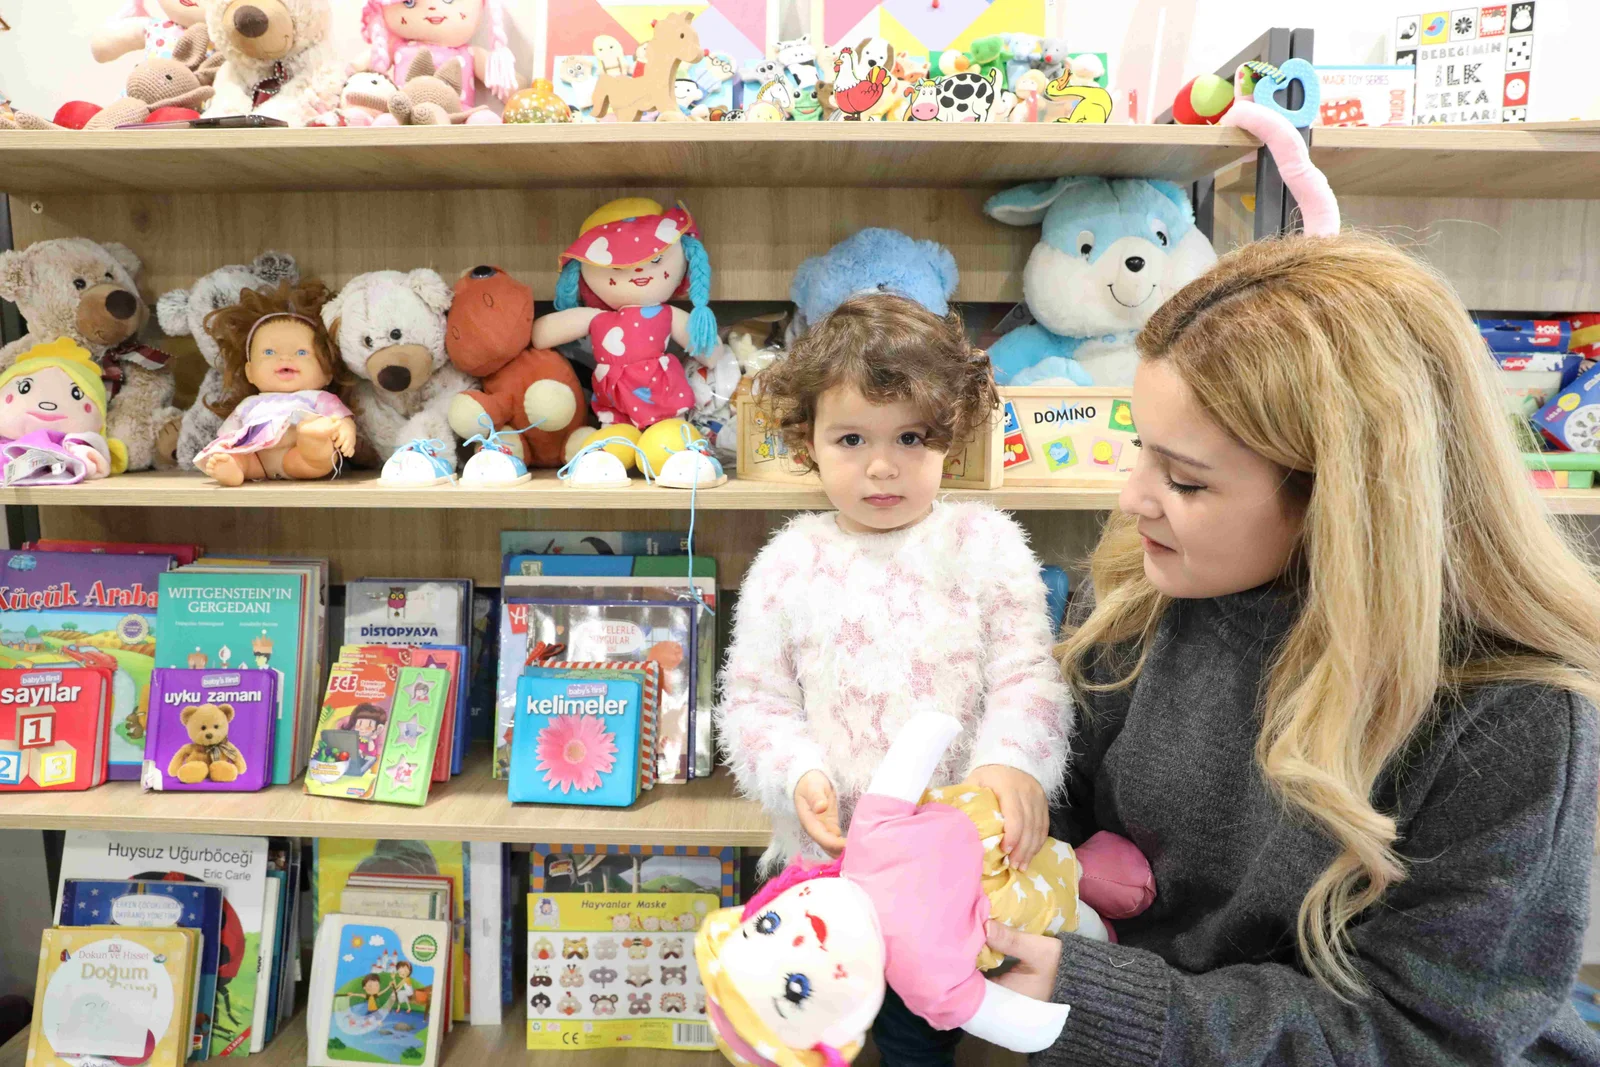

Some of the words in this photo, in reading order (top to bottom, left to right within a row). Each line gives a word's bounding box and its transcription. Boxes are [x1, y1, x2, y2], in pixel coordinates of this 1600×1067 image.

[1425, 89, 1489, 109] ZEKA
[1034, 406, 1096, 424] DOMINO
[83, 580, 158, 607] Araba
[188, 601, 271, 613] GERGEDANI
[22, 674, 45, 684] baby's
[46, 673, 60, 682] first
[329, 675, 357, 691] ECE
[0, 683, 81, 707] sayılar
[164, 689, 201, 706] uyku
[207, 690, 262, 702] zamanı
[568, 686, 591, 695] baby's
[591, 685, 606, 694] first
[526, 694, 628, 715] kelimeler
[28, 719, 46, 743] 1
[51, 757, 67, 779] 3
[108, 842, 164, 861] Huysuz
[169, 846, 253, 867] Uğurböceği
[203, 868, 223, 878] Eric
[225, 870, 251, 881] Carle
[581, 900, 631, 910] Hayvanlar
[636, 900, 667, 909] Maske
[78, 950, 108, 959] Dokun
[123, 951, 149, 960] Hisset
[81, 962, 149, 984] Doğum
